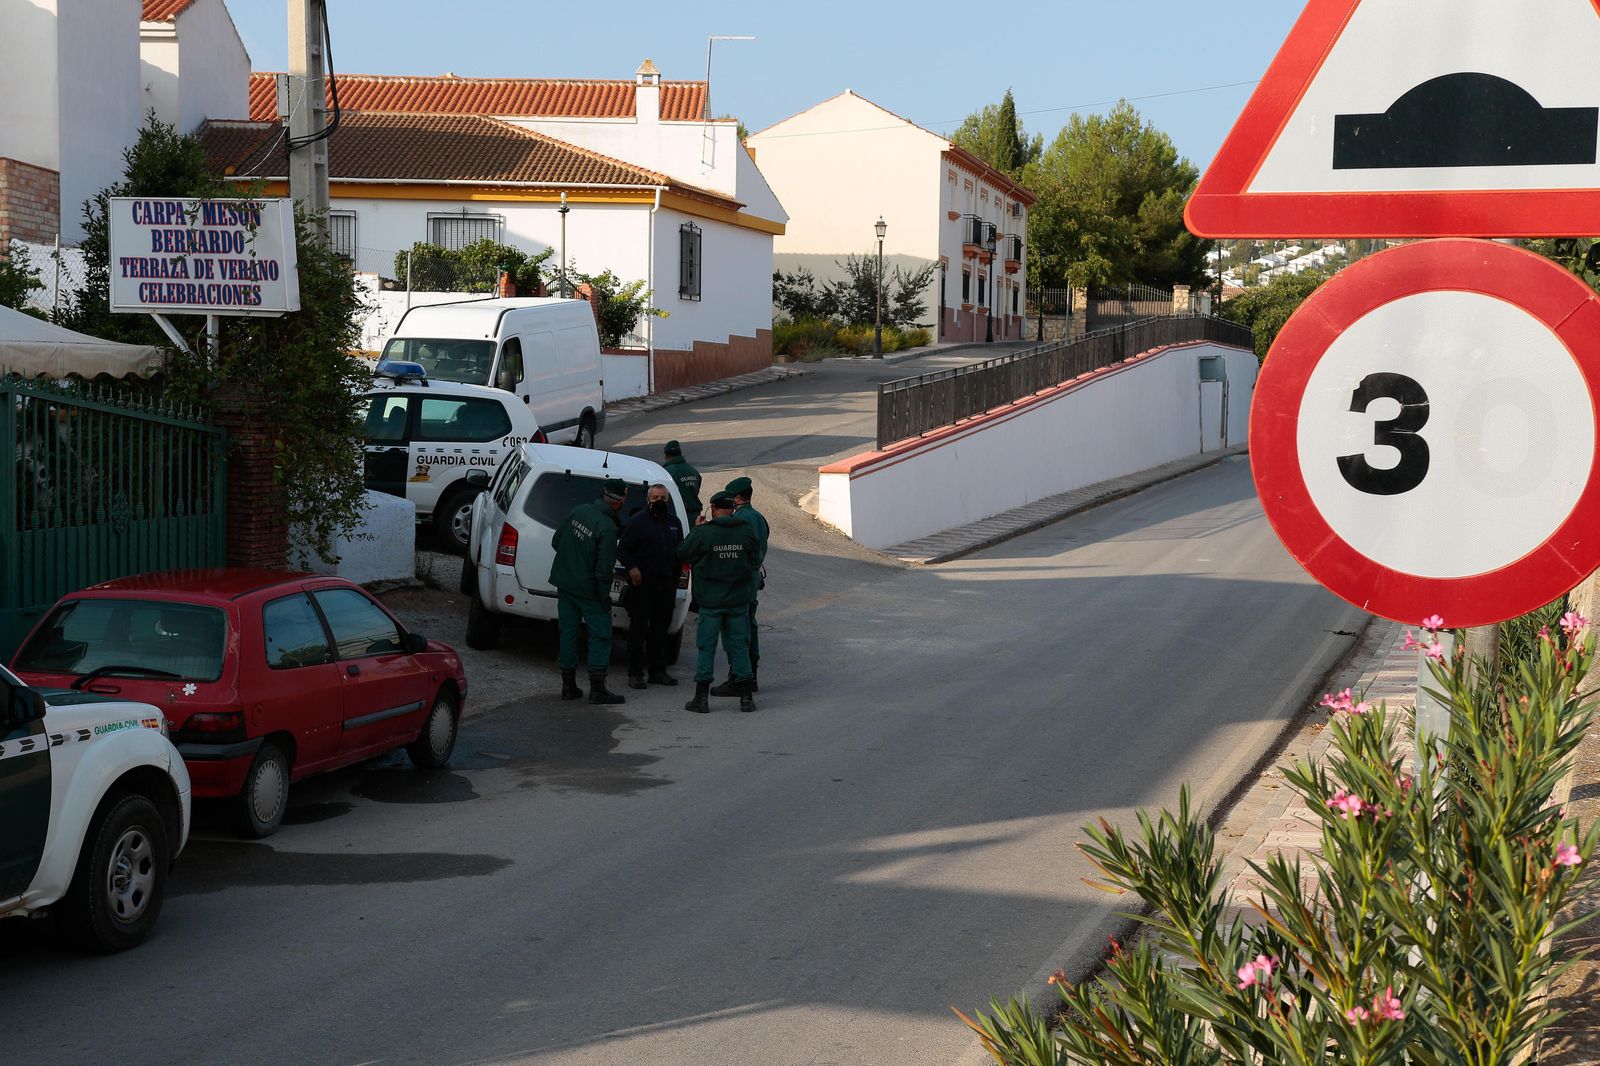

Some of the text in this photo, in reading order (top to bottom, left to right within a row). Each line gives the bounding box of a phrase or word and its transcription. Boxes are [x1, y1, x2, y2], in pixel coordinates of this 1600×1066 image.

[132, 201, 187, 225] CARPA
[151, 229, 245, 254] BERNARDO
[120, 257, 279, 281] TERRAZA DE VERANO
[138, 282, 262, 306] CELEBRACIONES
[416, 455, 496, 467] GUARDIA CIVIL
[713, 544, 744, 552] GUARDIA
[94, 719, 139, 734] GUARDIA CIVIL
